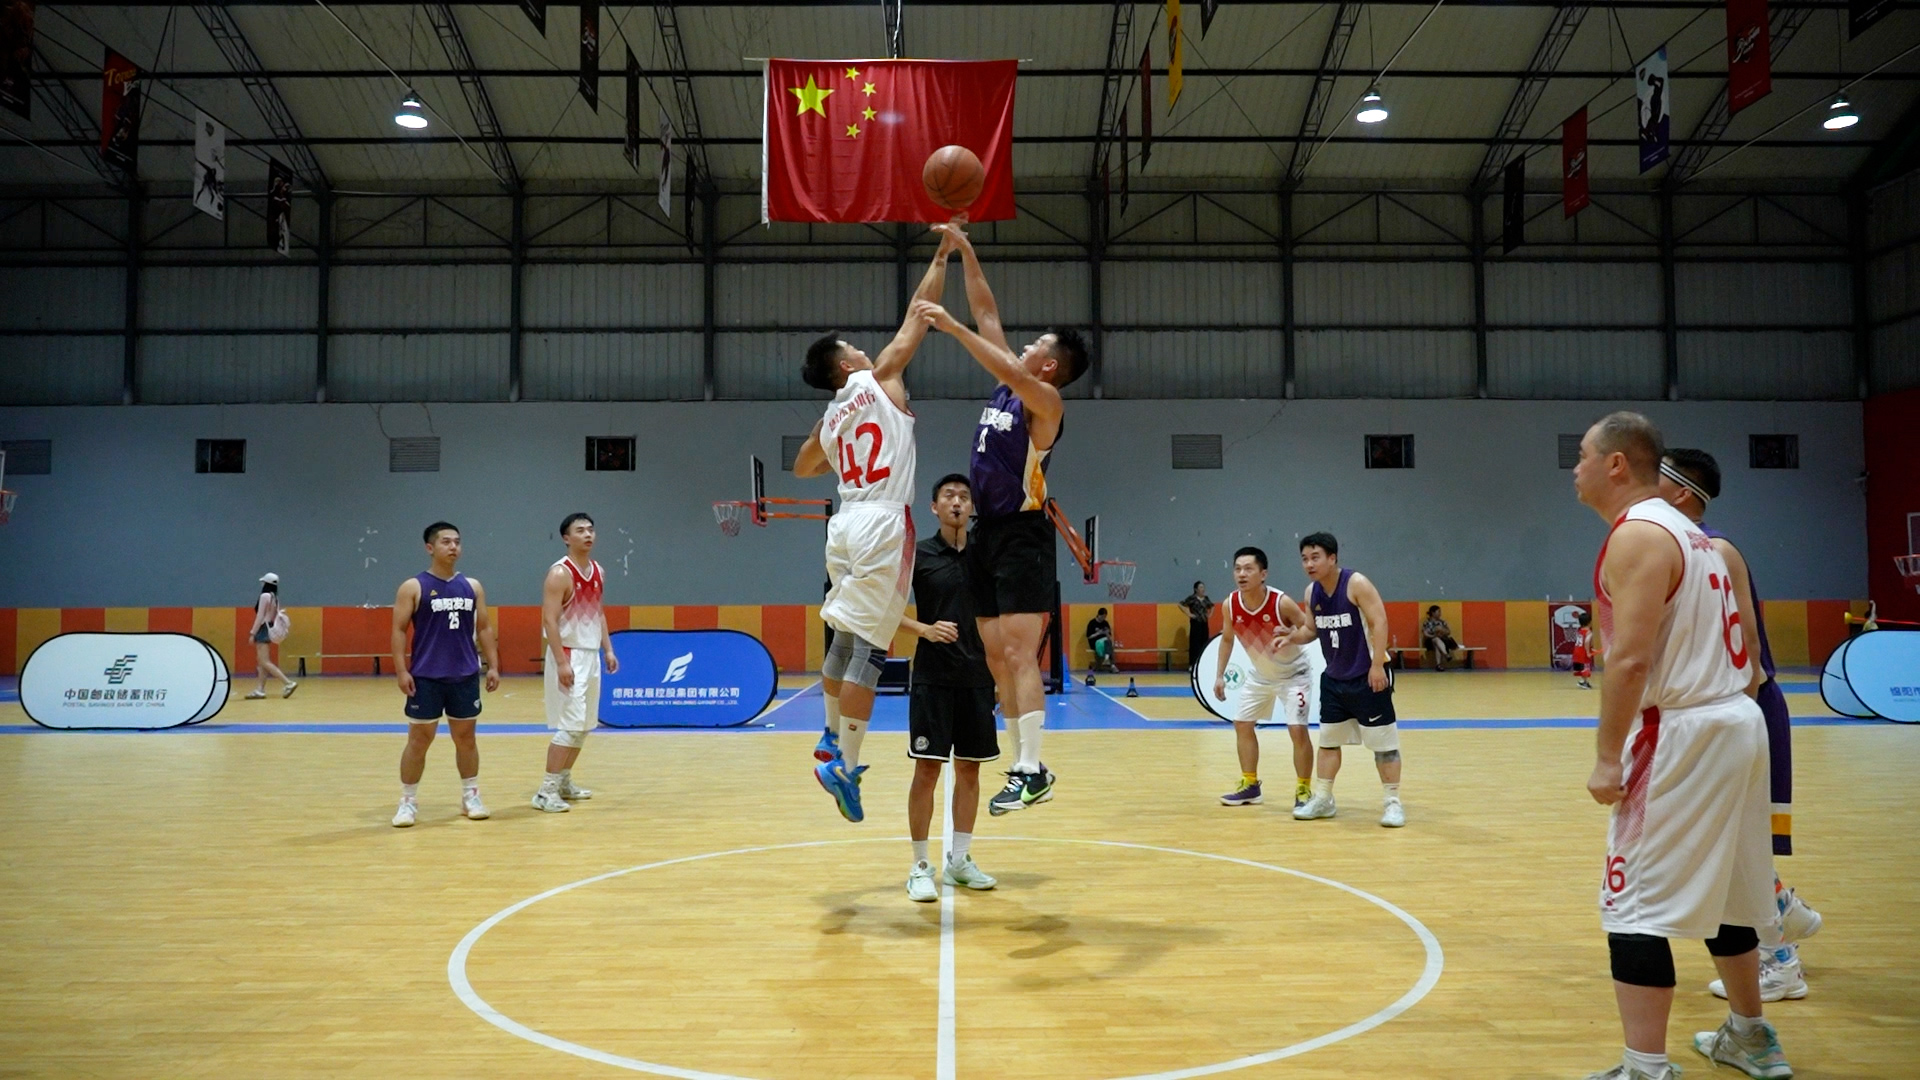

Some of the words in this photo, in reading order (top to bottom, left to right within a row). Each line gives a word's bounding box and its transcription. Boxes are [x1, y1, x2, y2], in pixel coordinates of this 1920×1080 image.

[837, 422, 890, 488] 42
[448, 611, 460, 630] 25
[64, 688, 167, 700] 中国邮政储蓄银行
[1296, 692, 1305, 707] 3
